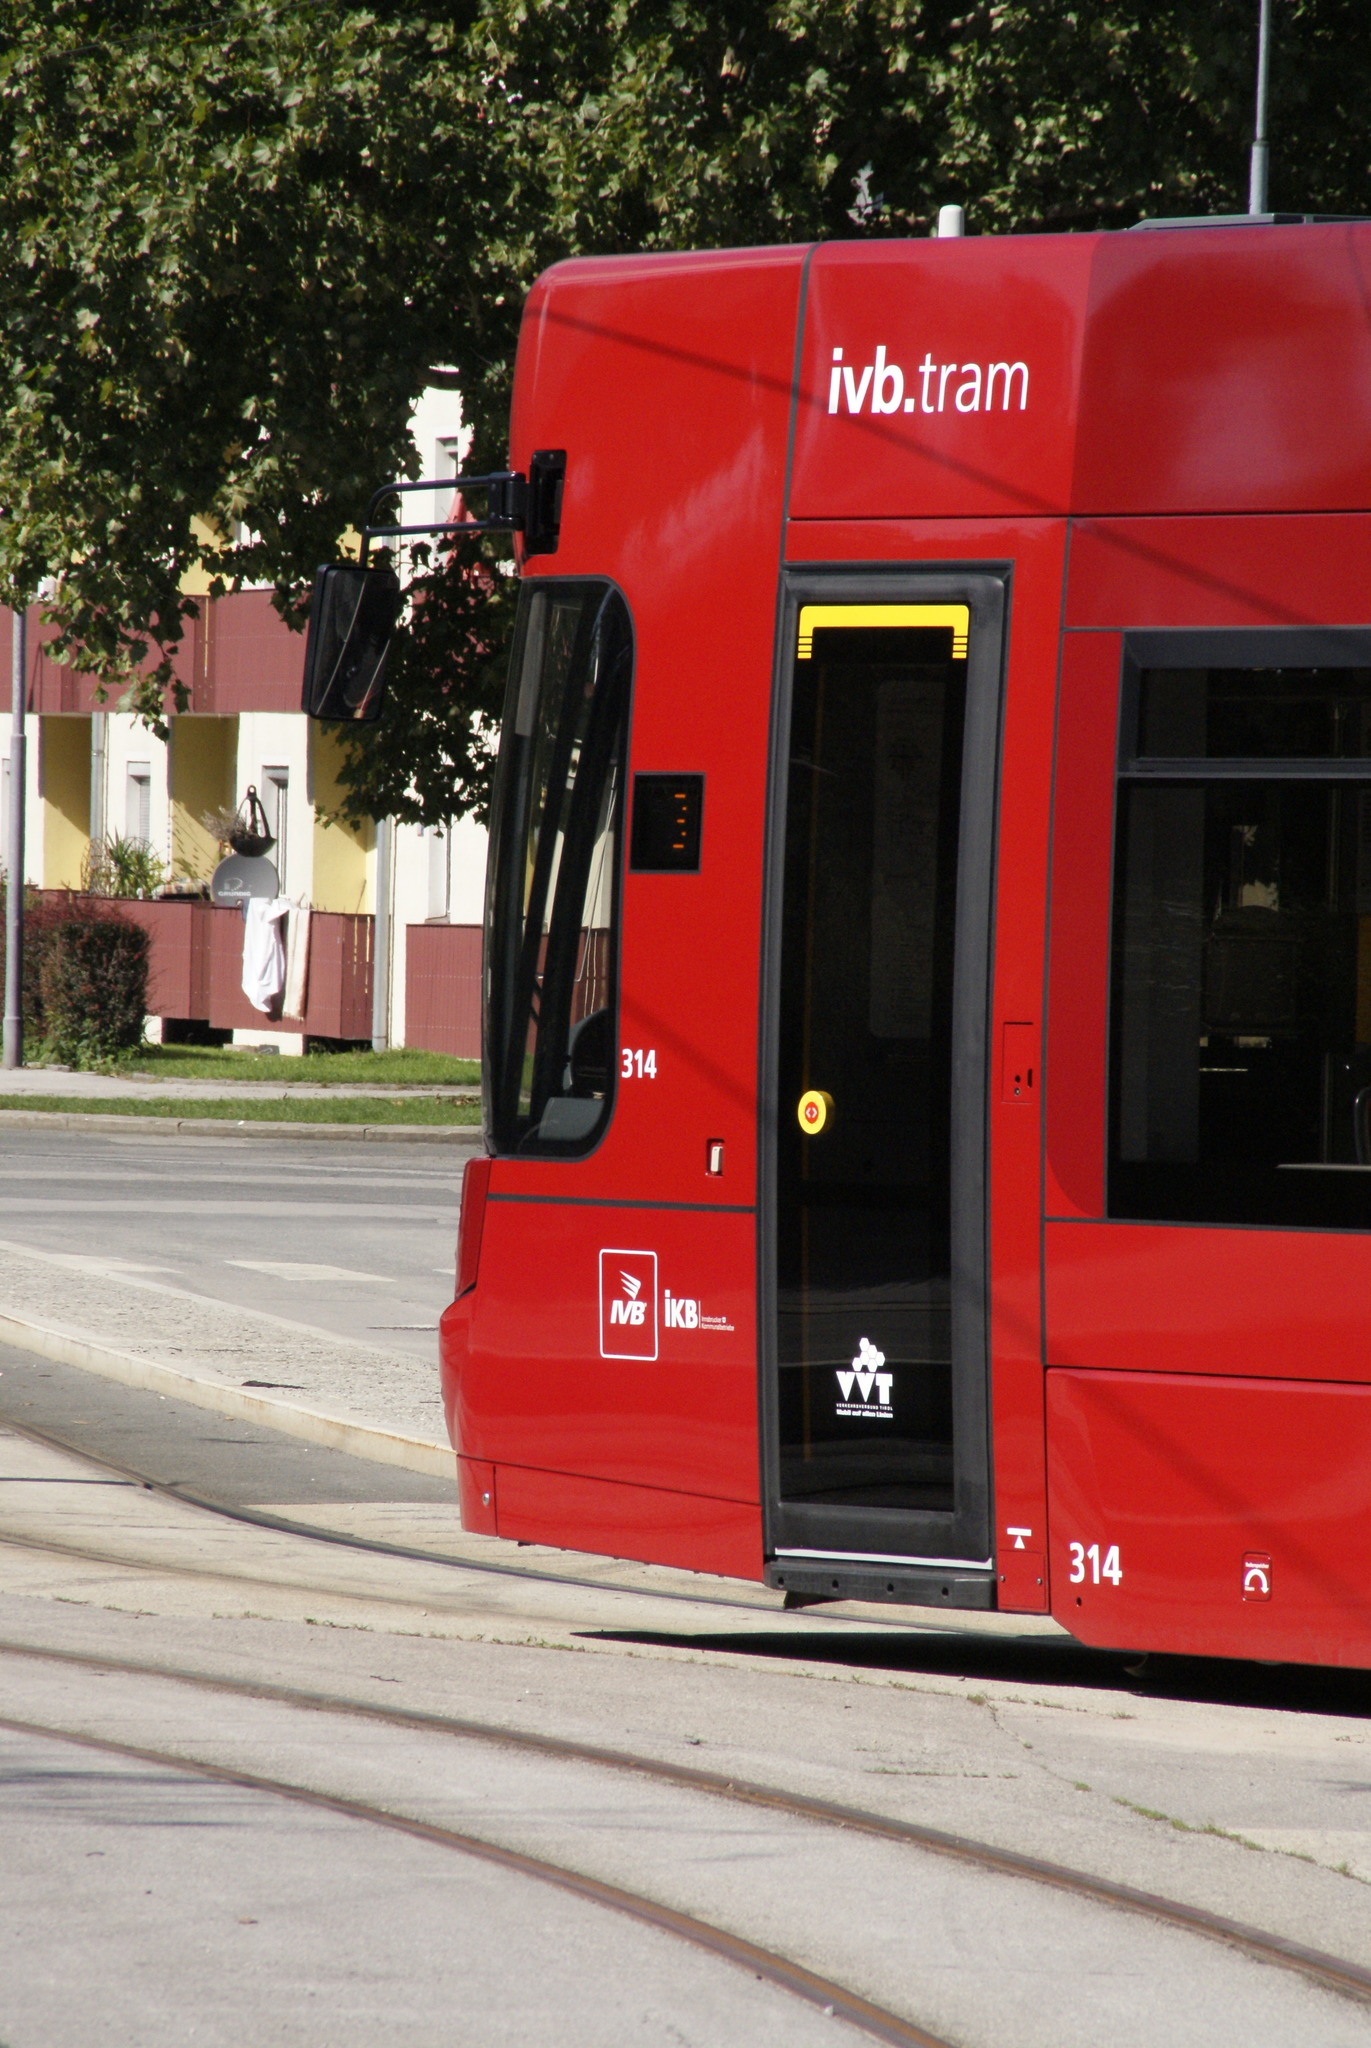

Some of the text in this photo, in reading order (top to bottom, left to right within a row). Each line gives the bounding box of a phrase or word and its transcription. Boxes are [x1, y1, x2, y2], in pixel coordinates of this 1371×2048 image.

[828, 345, 1030, 414] ivb.tram
[621, 1048, 658, 1079] 314
[836, 1370, 893, 1405] VVT
[1069, 1541, 1123, 1586] 314
